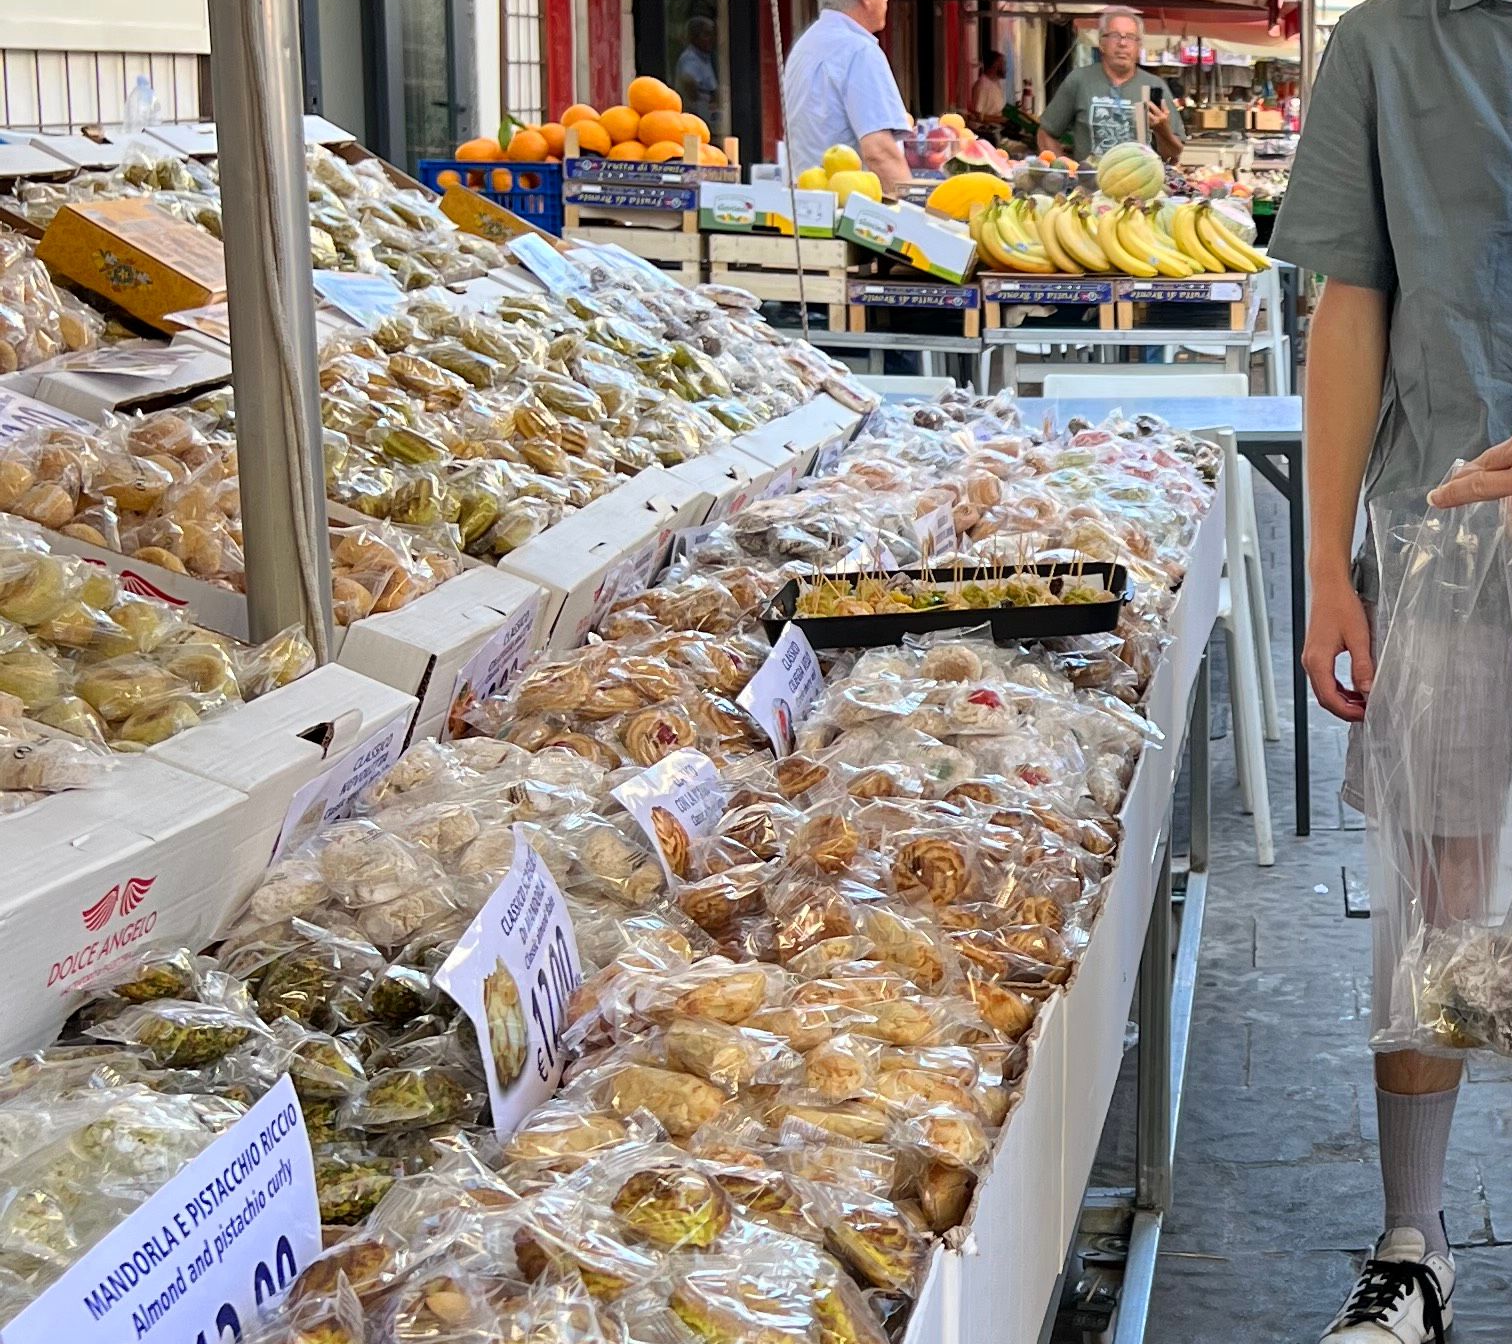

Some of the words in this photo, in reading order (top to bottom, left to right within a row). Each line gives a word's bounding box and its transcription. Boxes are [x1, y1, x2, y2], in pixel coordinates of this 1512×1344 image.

[83, 1225, 181, 1321] MANDORLA
[173, 1212, 191, 1239] E
[185, 1142, 261, 1228] PISTACCHIO
[260, 1103, 298, 1156] RICCIO
[131, 1266, 188, 1340] Almond
[188, 1239, 215, 1284] and
[214, 1189, 266, 1264] pistachio
[267, 1156, 293, 1199] curly
